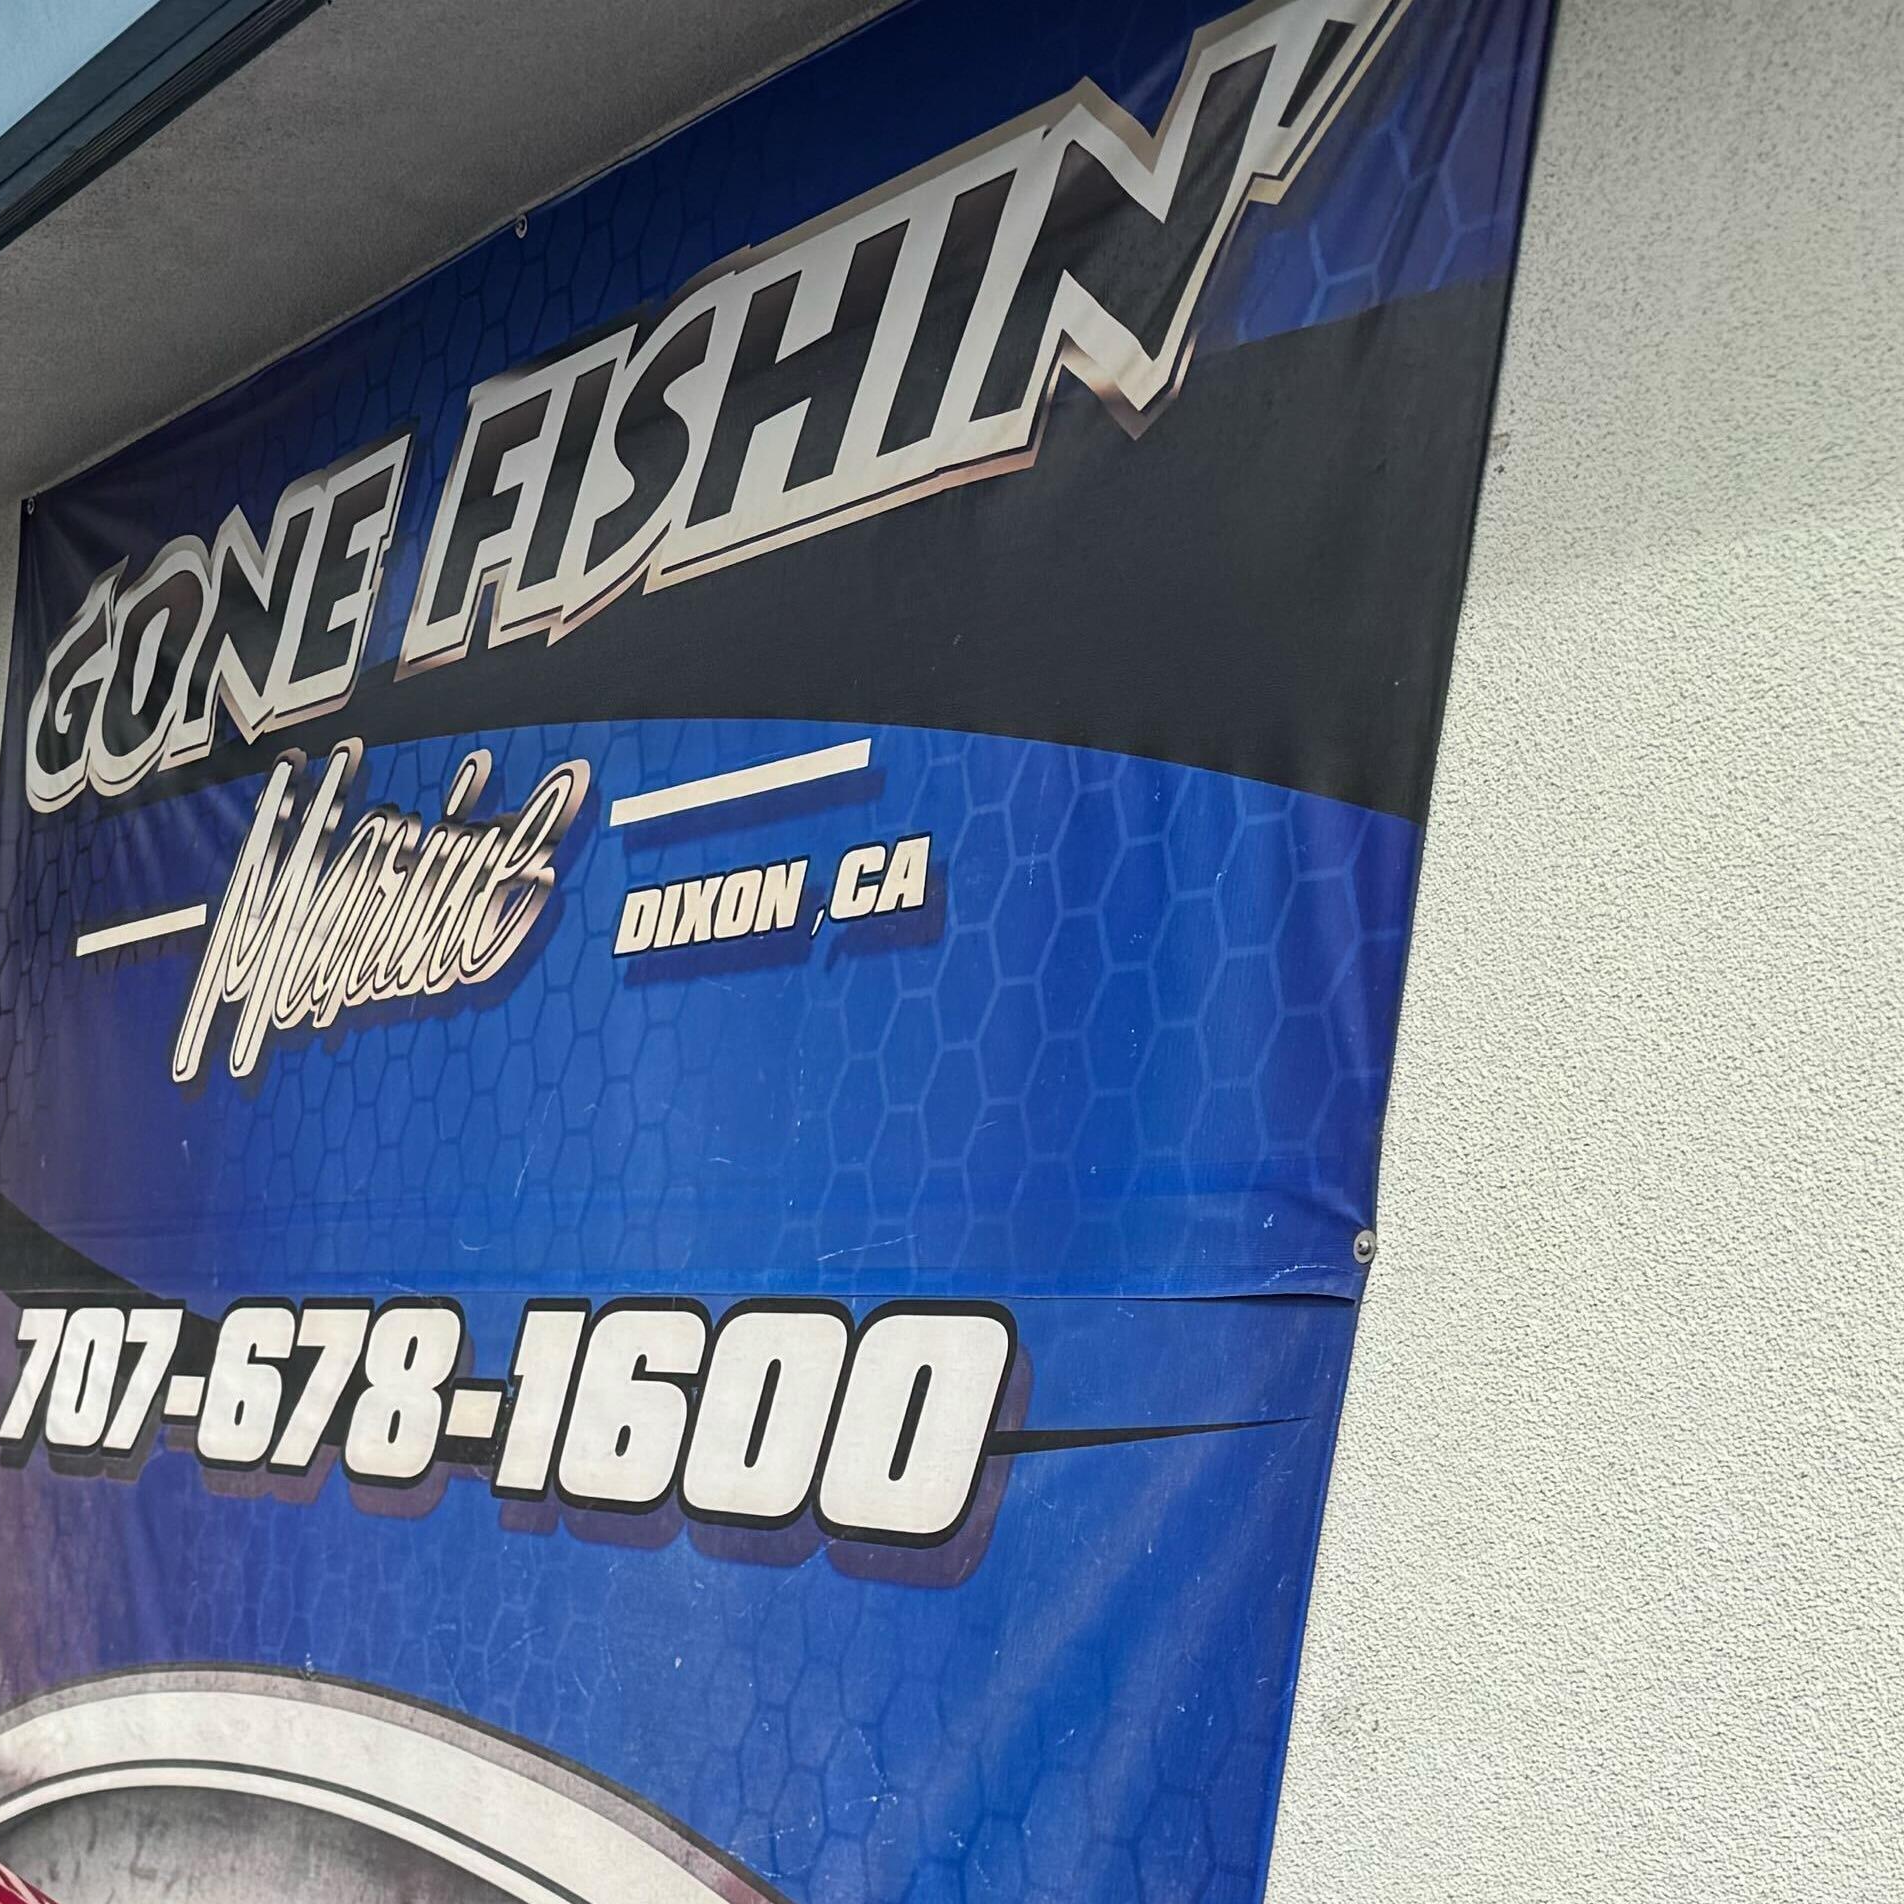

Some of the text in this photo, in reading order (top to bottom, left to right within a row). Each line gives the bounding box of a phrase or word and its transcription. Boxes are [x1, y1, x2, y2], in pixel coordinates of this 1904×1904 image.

[26, 0, 1410, 813] GONE FISHIN'
[173, 737, 591, 1082] Marine
